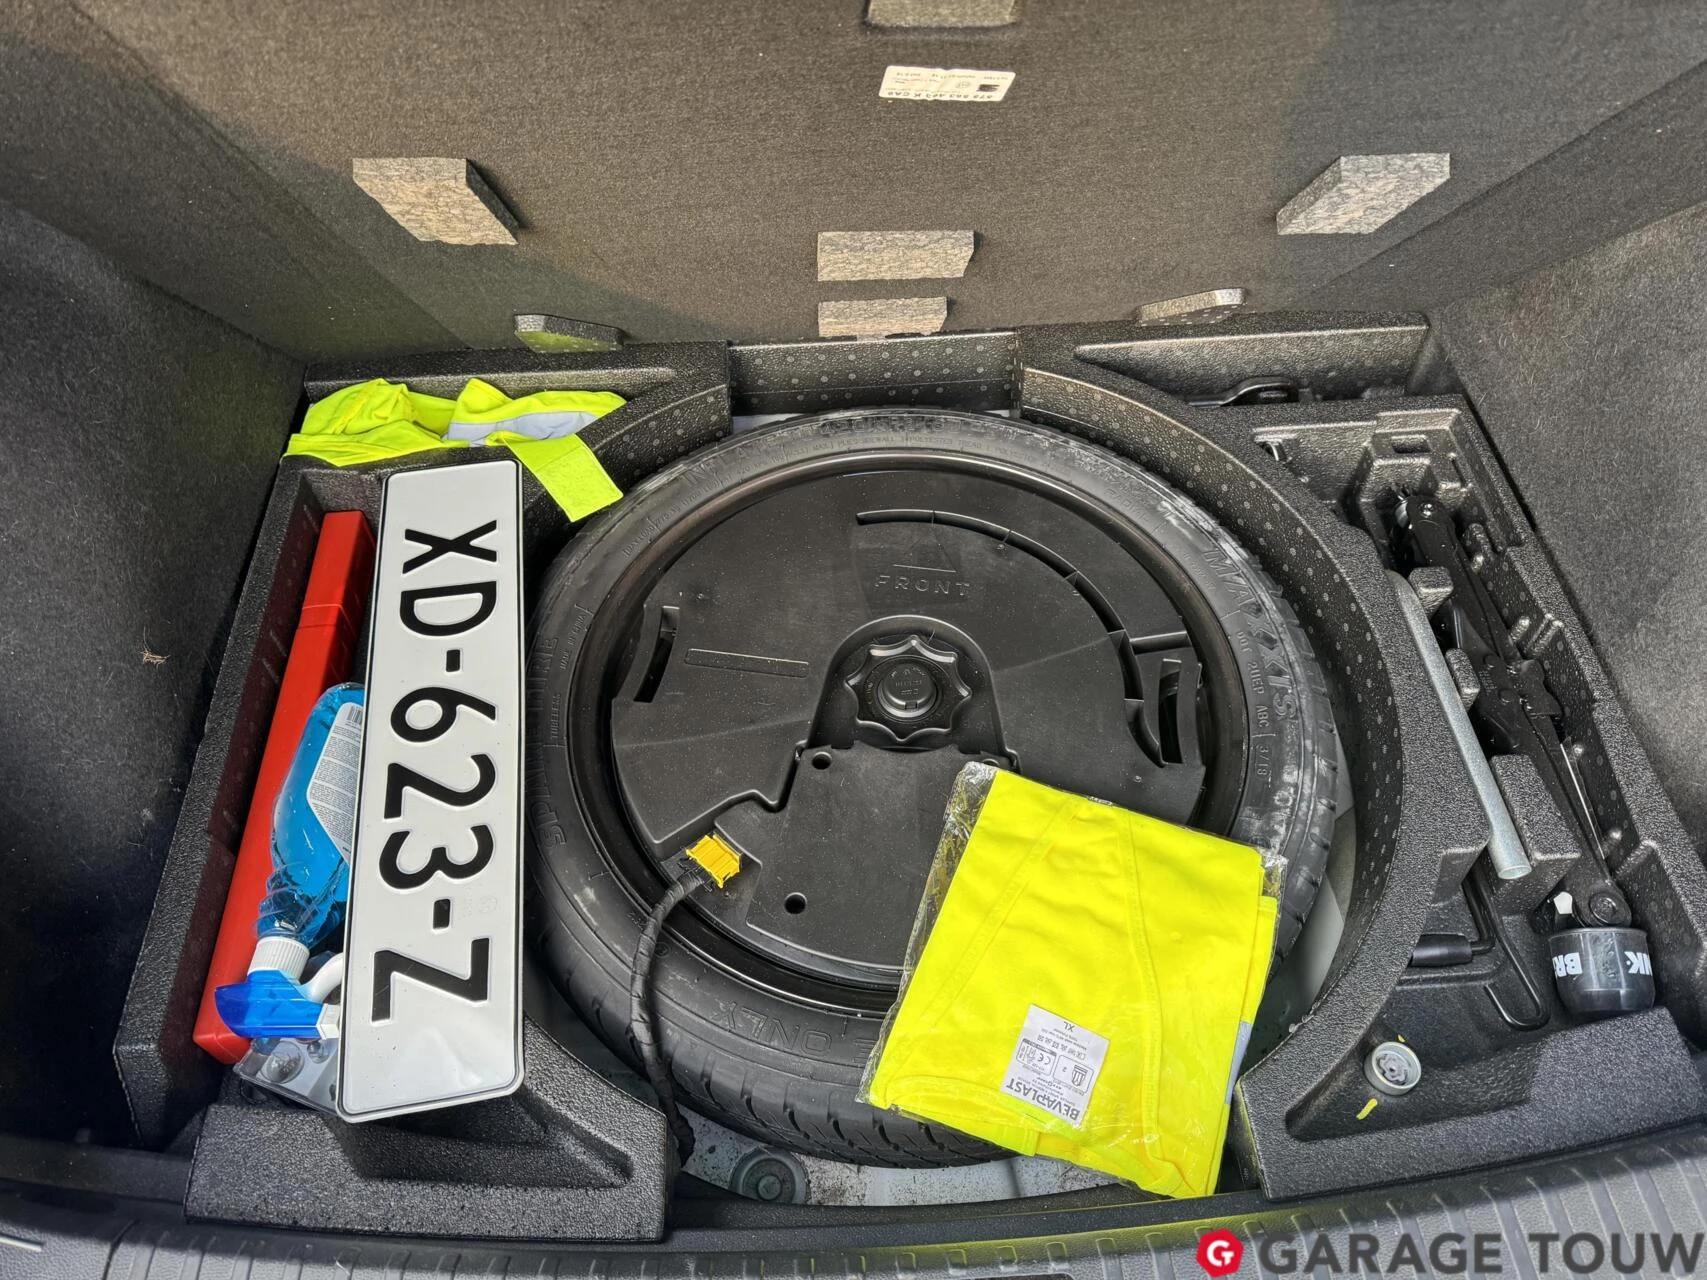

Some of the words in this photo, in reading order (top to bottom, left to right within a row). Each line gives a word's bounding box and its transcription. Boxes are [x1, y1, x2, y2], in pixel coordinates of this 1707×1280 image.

[873, 574, 970, 597] FRONT
[1202, 548, 1299, 721] MAXXIS
[372, 520, 497, 1021] XD-623-Z
[712, 1000, 833, 1056] ONLY
[1061, 1020, 1075, 1032] XL
[1006, 1078, 1081, 1121] BEVAPLAST
